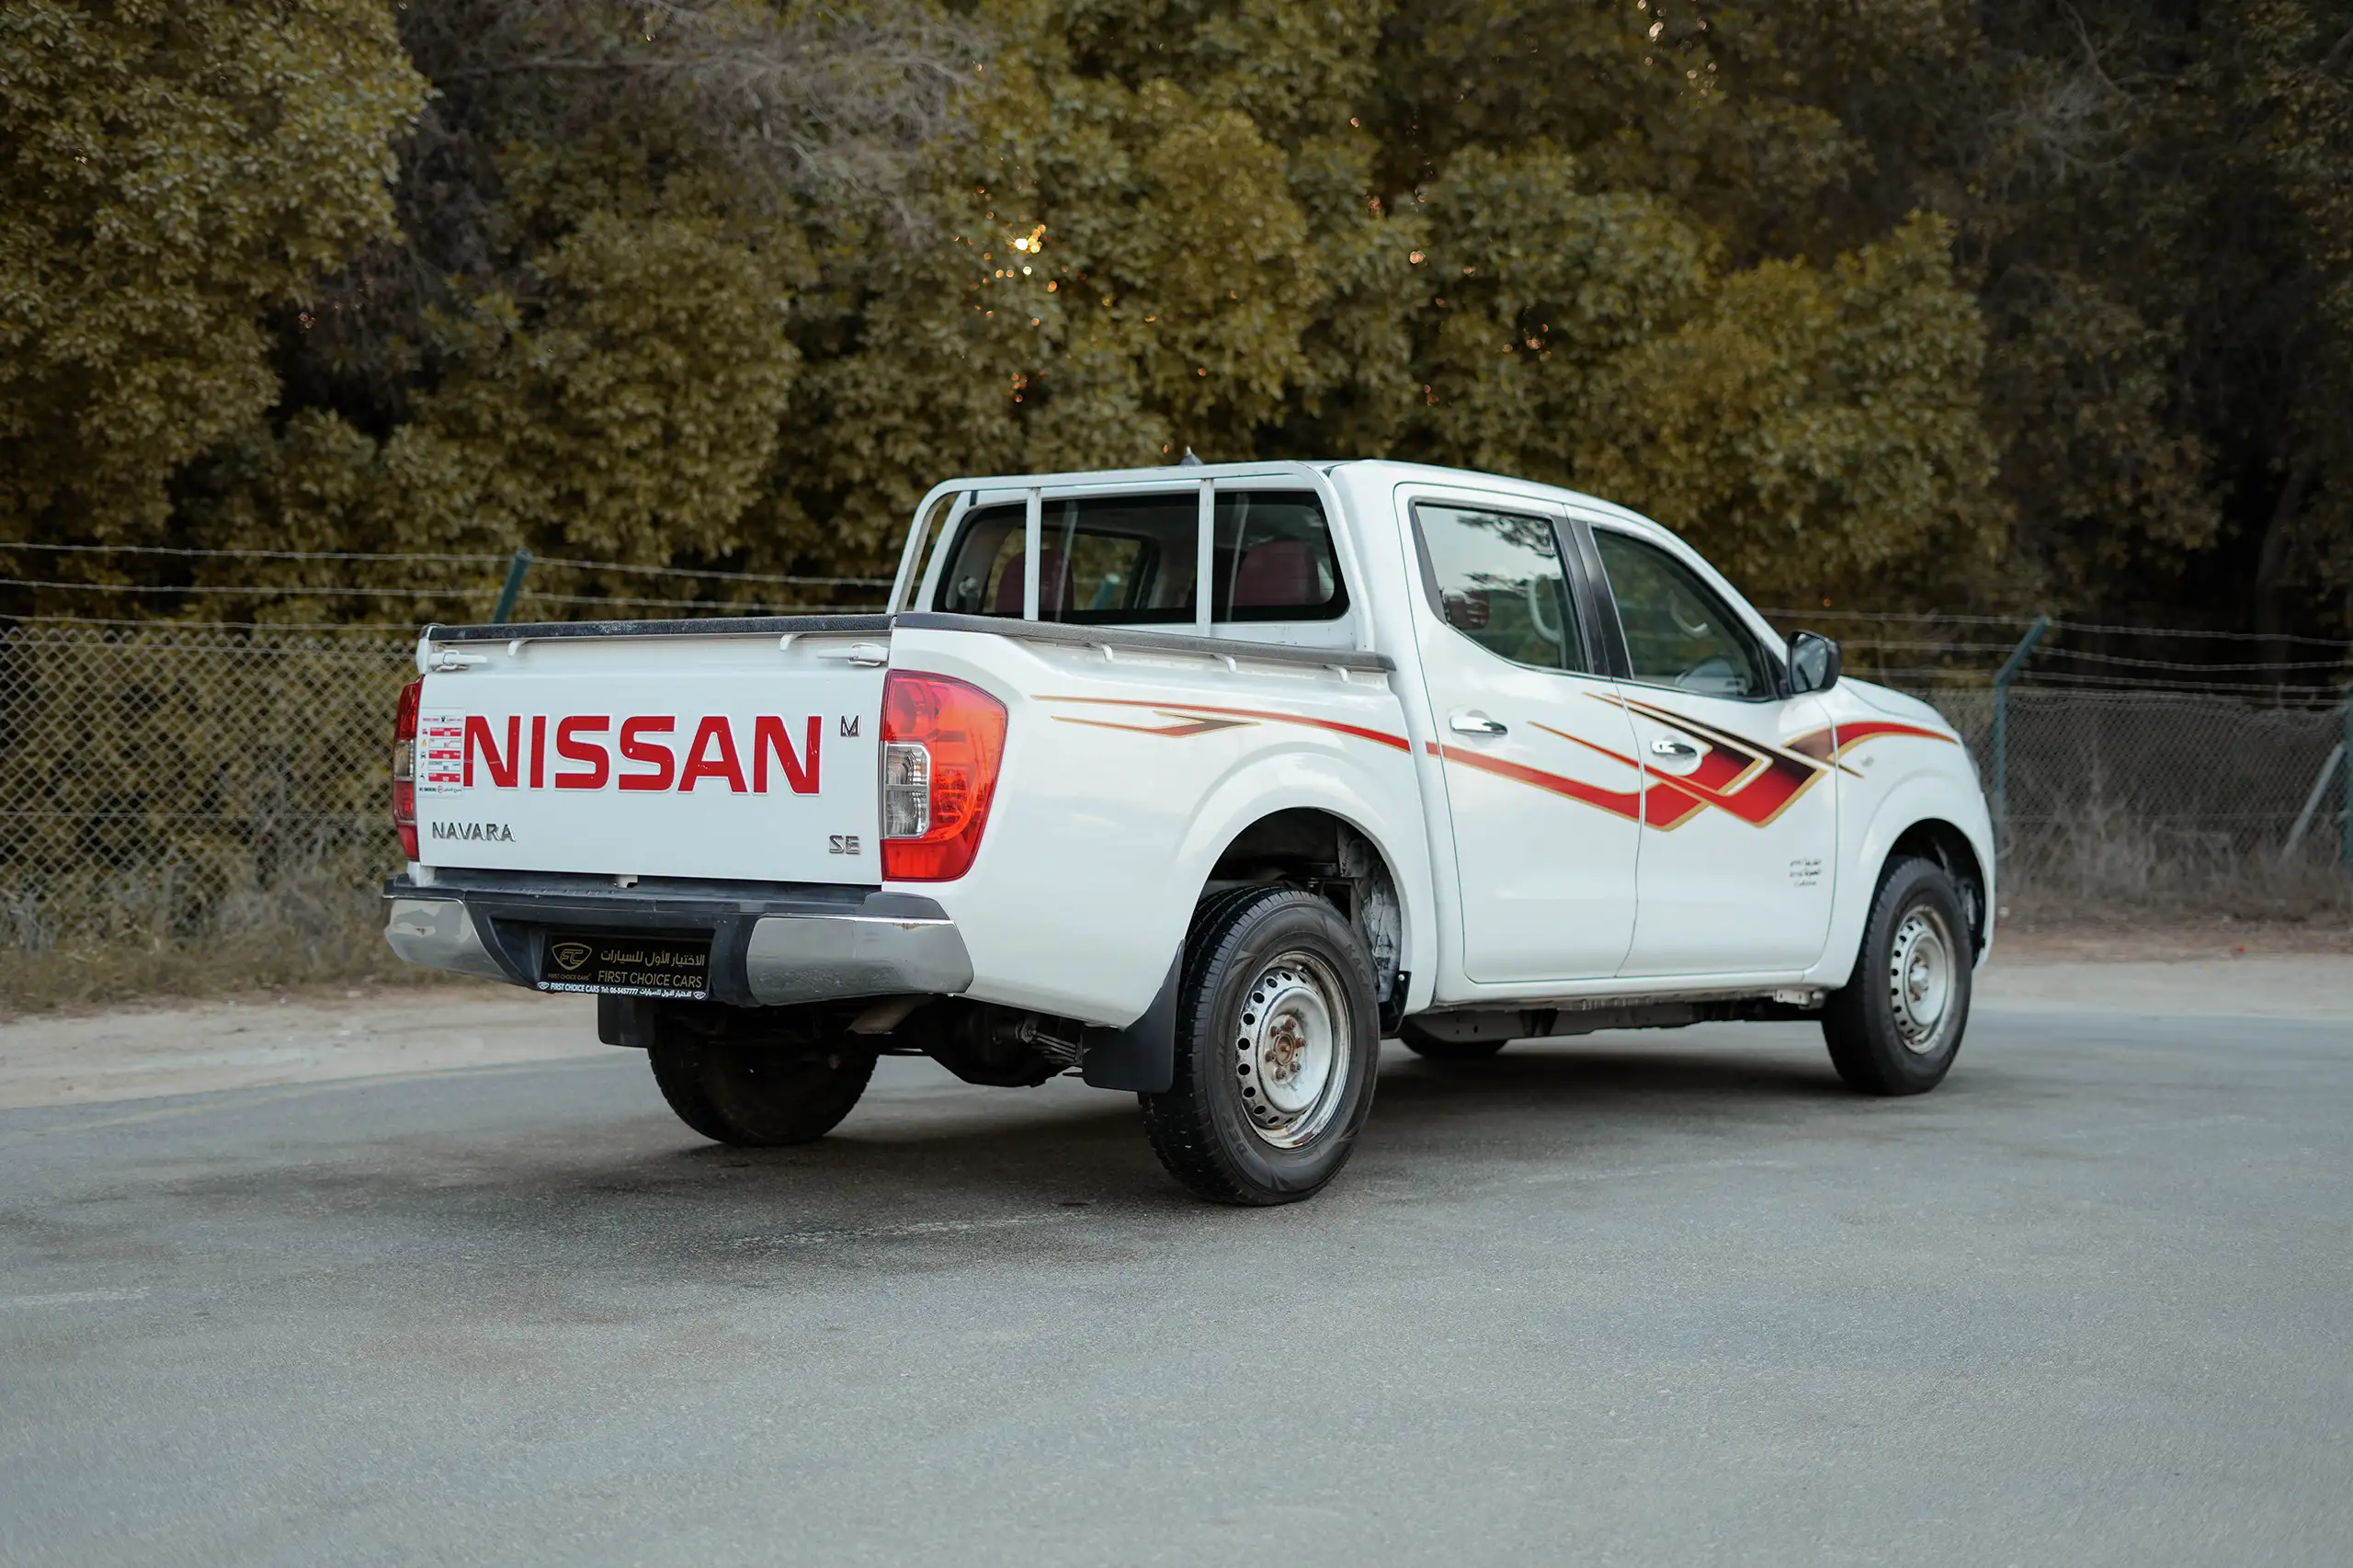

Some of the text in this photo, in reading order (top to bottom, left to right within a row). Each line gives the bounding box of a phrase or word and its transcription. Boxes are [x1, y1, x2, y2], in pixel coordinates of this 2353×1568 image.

[462, 714, 823, 795] NISSAN
[432, 822, 516, 842] NAVARA
[829, 835, 860, 855] SE
[600, 949, 706, 968] الاختيار الأول للسيارات
[550, 983, 564, 991] FIRST
[564, 983, 585, 992] CHOICE
[585, 984, 600, 994] CARS
[597, 970, 703, 988] FIRST CHOICE CARS
